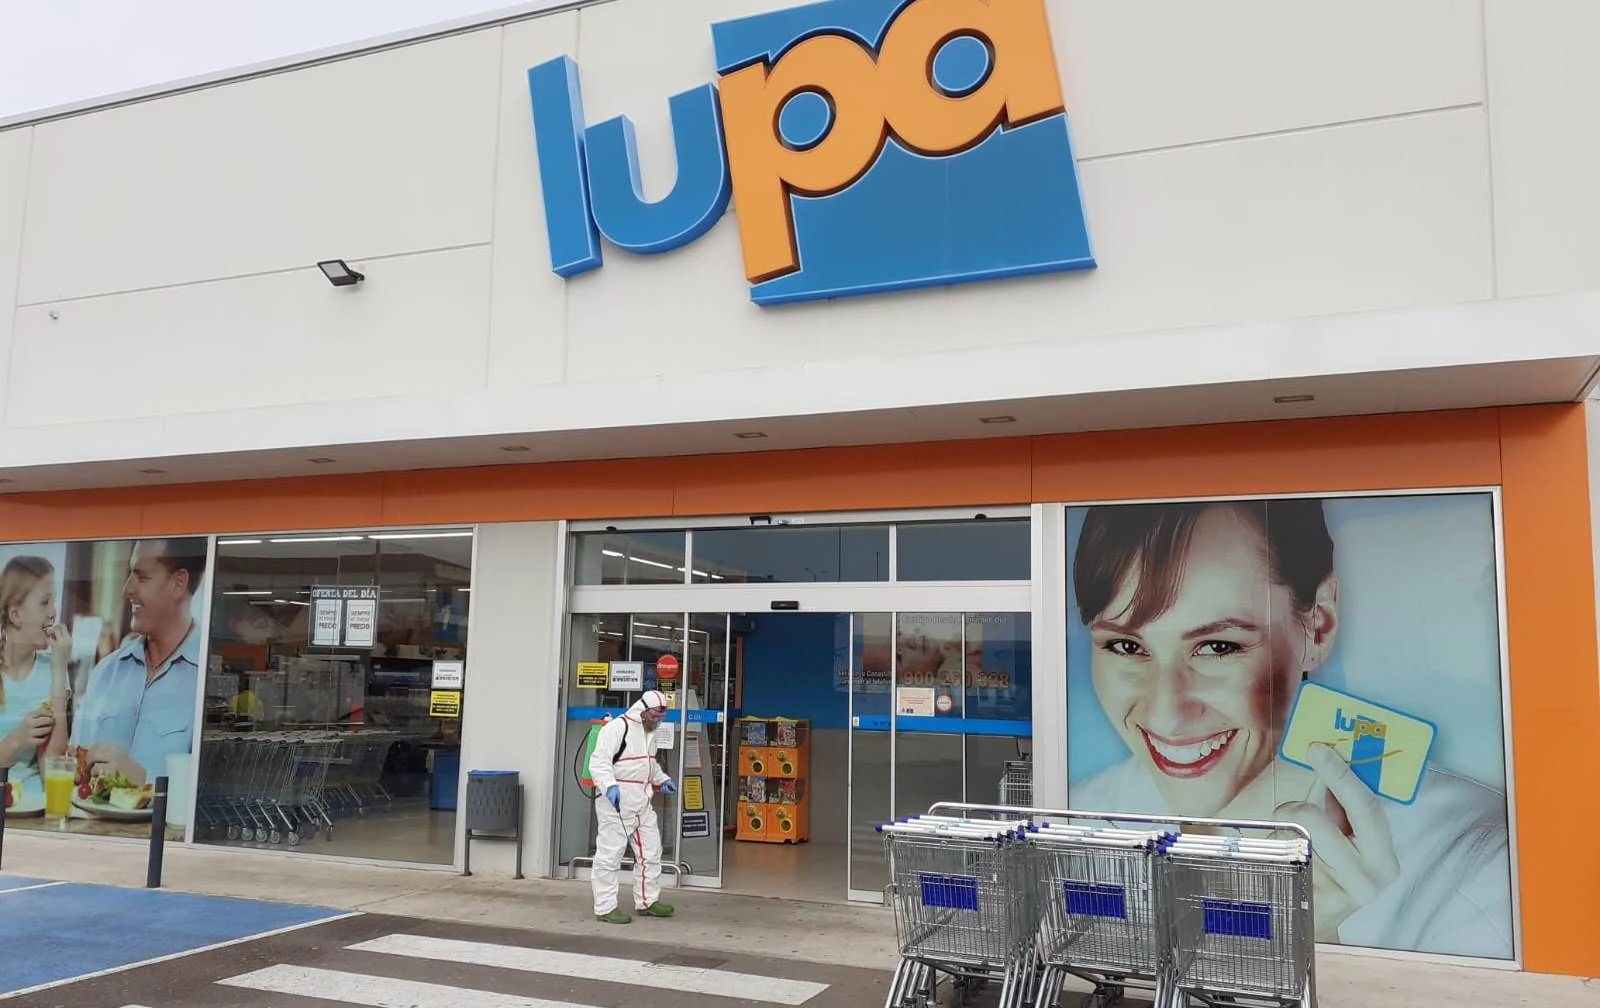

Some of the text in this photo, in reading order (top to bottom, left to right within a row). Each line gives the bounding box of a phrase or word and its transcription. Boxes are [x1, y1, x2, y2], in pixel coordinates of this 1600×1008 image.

[527, 0, 1067, 281] lupa
[312, 587, 377, 599] OFERTA DEL DÍA
[904, 670, 935, 686] 900
[1334, 707, 1388, 741] lupa
